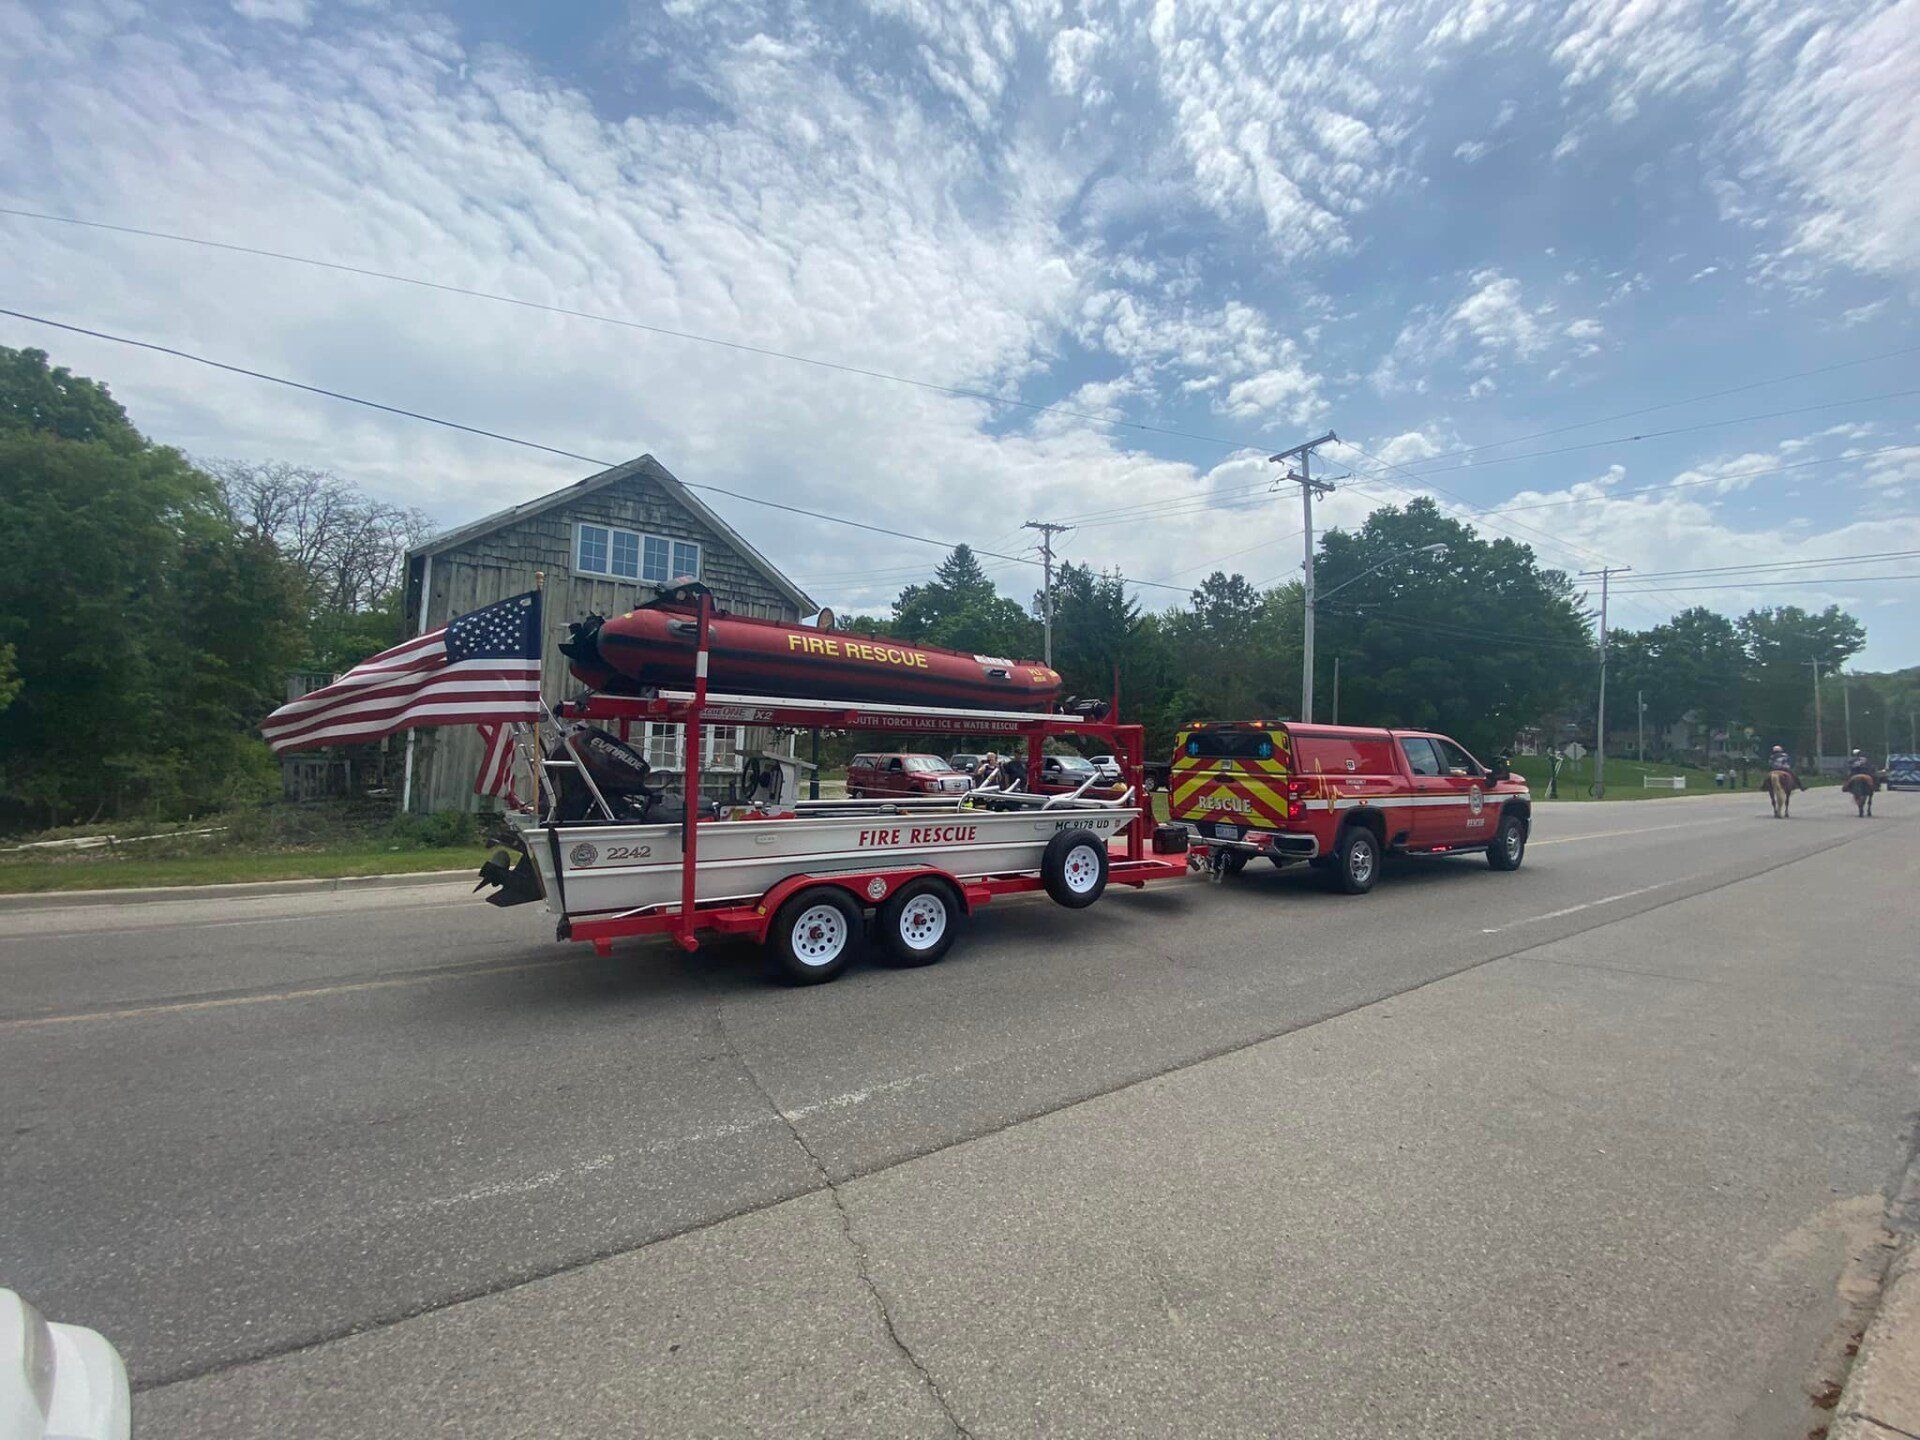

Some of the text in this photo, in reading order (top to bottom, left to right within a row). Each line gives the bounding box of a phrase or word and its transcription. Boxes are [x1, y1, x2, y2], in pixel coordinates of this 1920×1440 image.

[788, 635, 928, 668] FIRE RESCUE
[849, 716, 878, 726] OUTH
[882, 717, 912, 727] TORCH
[915, 719, 937, 728] LAKE
[938, 719, 951, 728] ICE
[963, 720, 990, 730] WATER
[991, 721, 1018, 731] RESCUE
[590, 737, 644, 770] EVINRUDE
[1198, 795, 1252, 812] RESCUE
[1055, 821, 1070, 830] MC
[1096, 820, 1109, 829] UD
[858, 826, 977, 846] FIRE RESCUE
[606, 845, 651, 860] 2242
